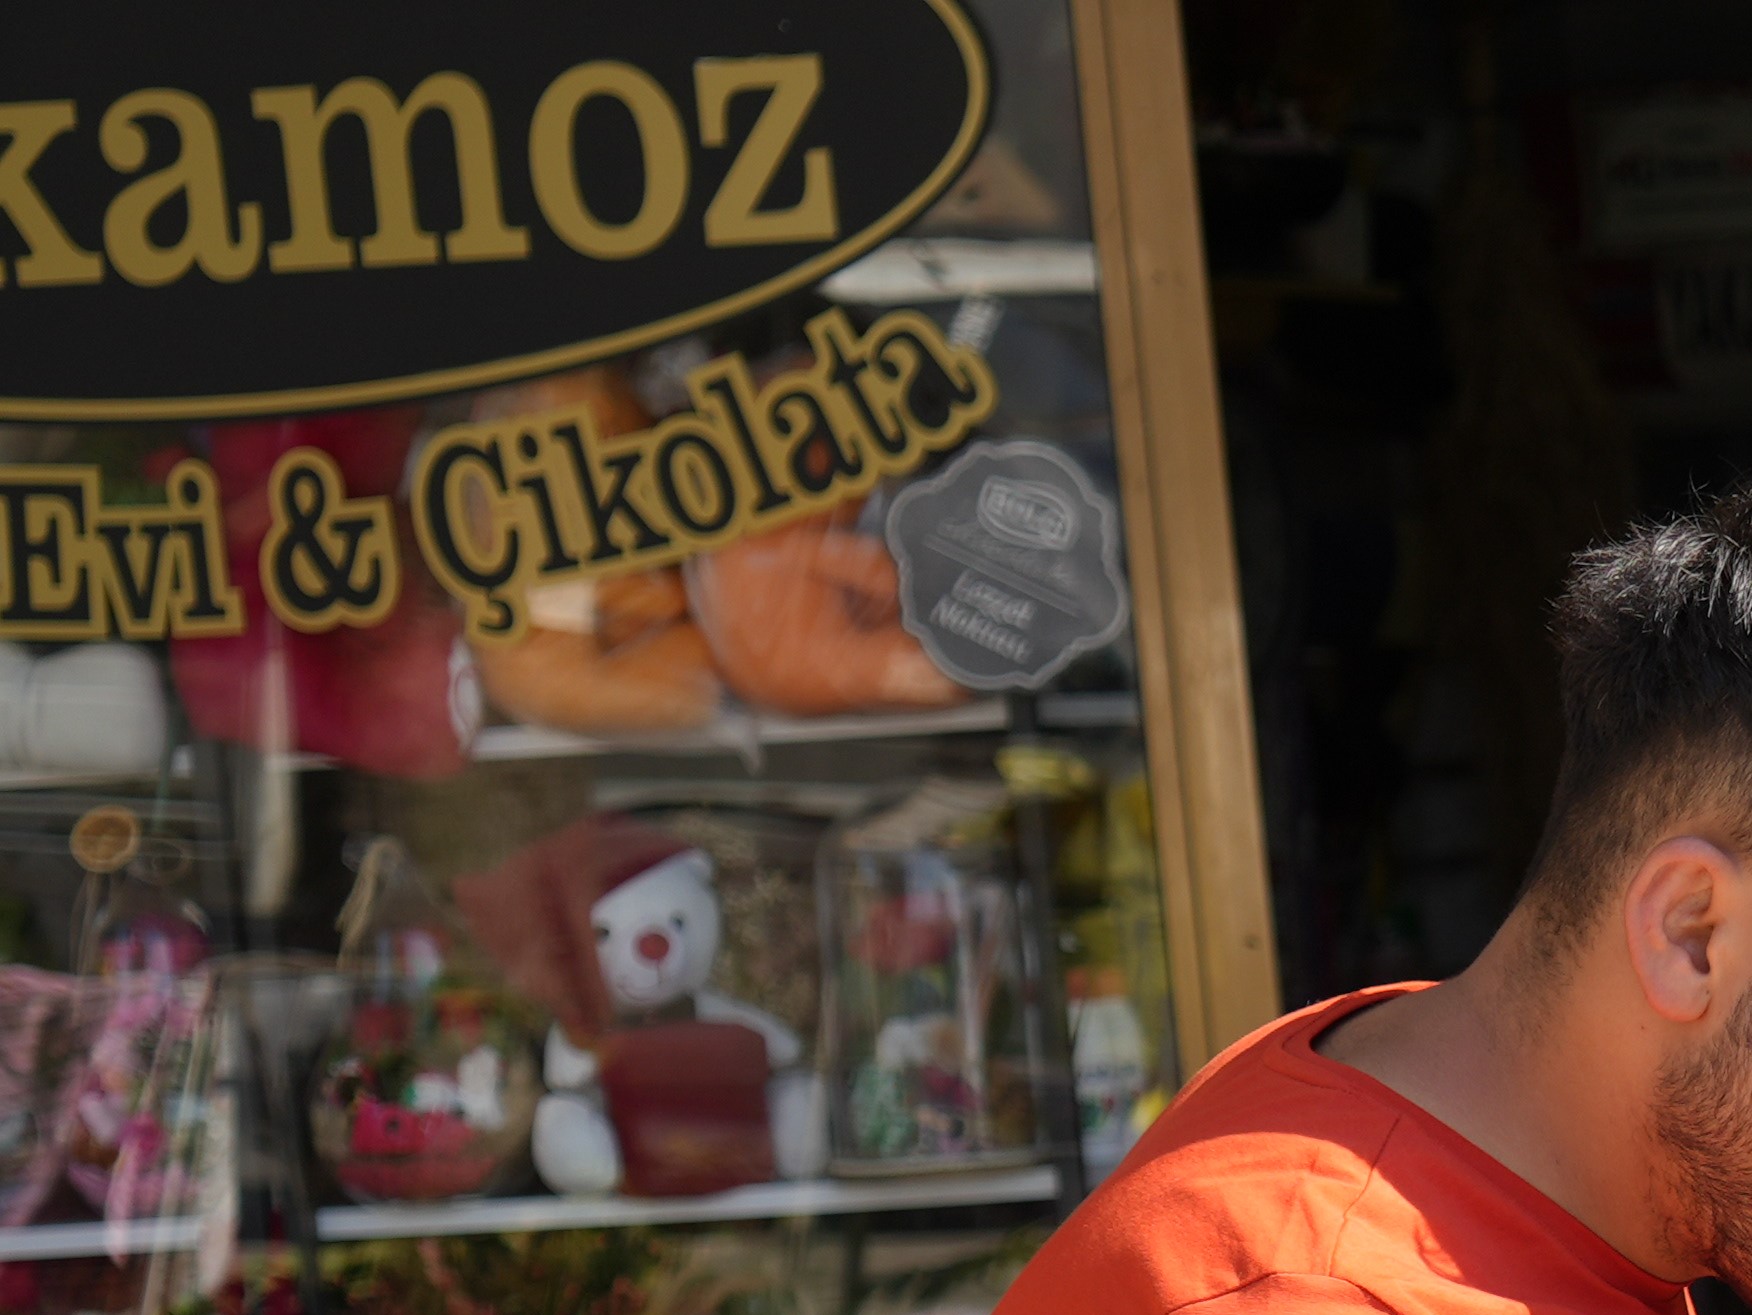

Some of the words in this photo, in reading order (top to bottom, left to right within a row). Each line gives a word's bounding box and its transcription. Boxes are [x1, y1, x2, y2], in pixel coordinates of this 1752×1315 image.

[0, 474, 230, 626] Evi
[274, 464, 384, 615] &
[422, 322, 980, 634] Çikolata
